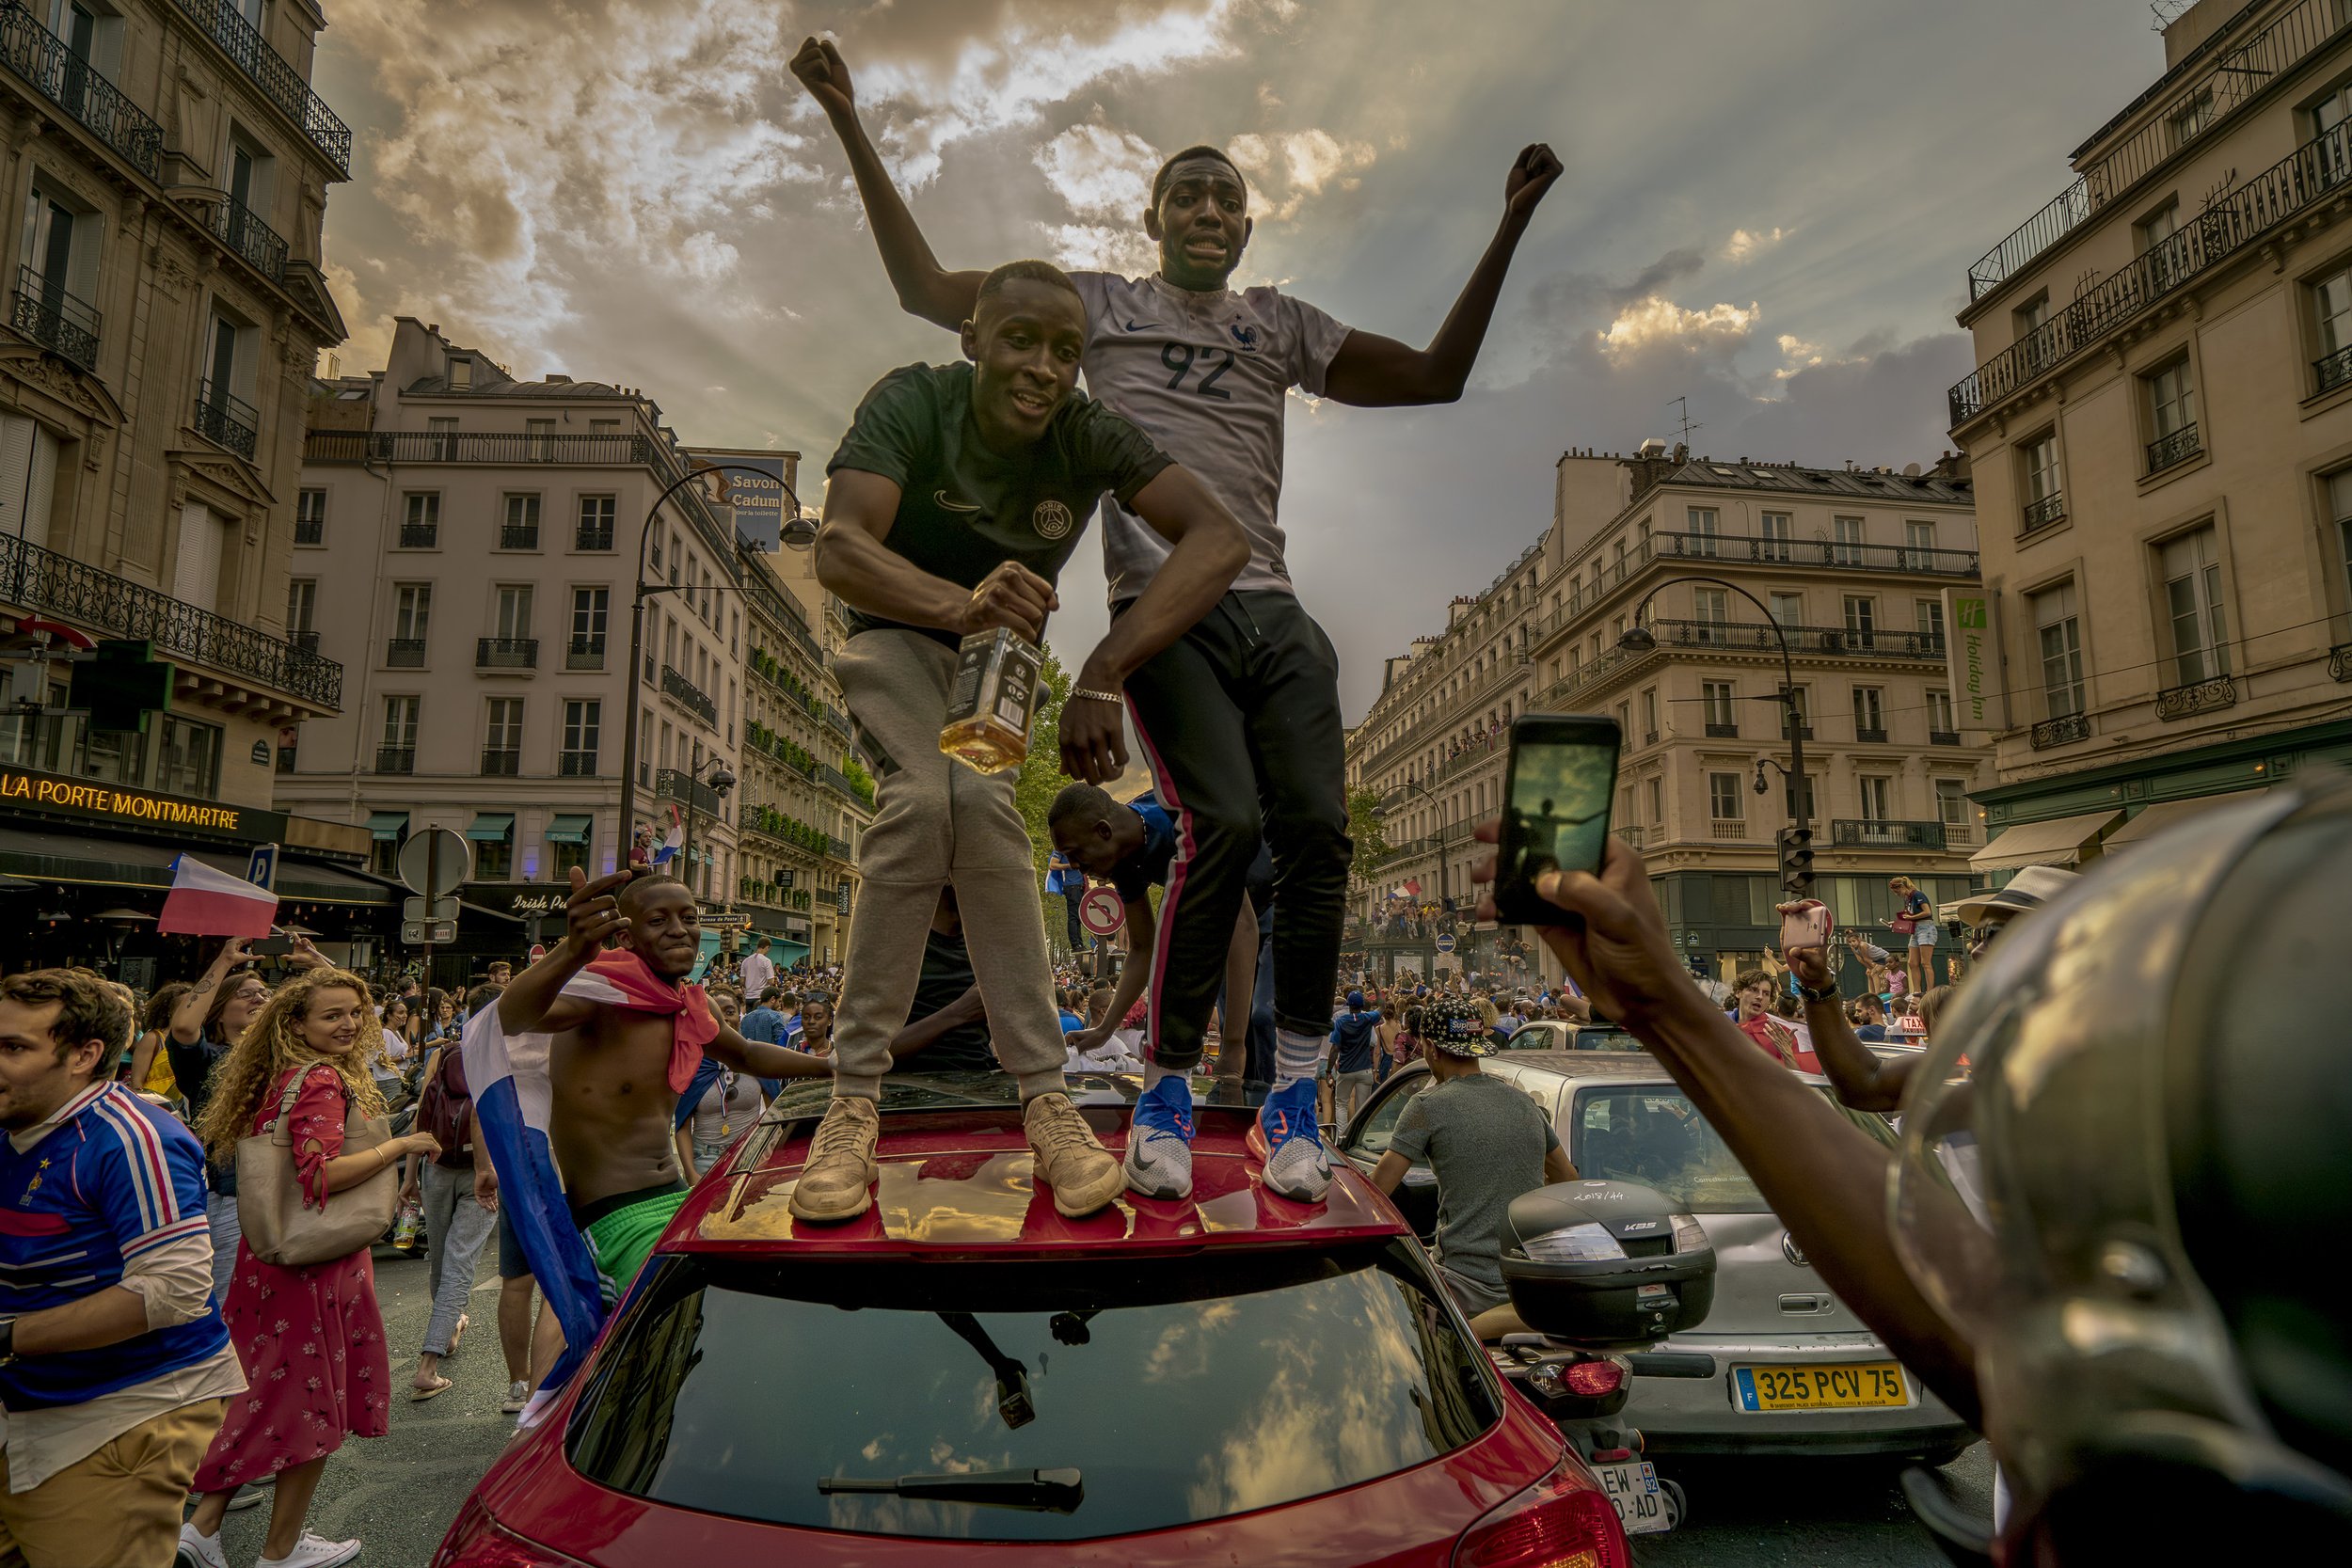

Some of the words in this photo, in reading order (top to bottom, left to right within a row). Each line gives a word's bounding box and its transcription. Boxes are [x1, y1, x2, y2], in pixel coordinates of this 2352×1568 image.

[1161, 341, 1235, 400] 92
[732, 475, 780, 489] Savon
[732, 494, 780, 508] Cadum
[1038, 502, 1063, 514] PARIS
[1966, 633, 1984, 693] Holiday
[1972, 696, 1987, 721] Inn
[1, 773, 30, 799] LA
[39, 780, 109, 810] PORTE
[113, 793, 240, 830] MONTMARTRE
[253, 858, 267, 883] P
[511, 895, 548, 909] Irish
[549, 895, 567, 910] Pu
[1905, 1019, 1923, 1028] TAX
[1759, 1371, 1810, 1400] 325
[1814, 1370, 1860, 1398] PCV
[1866, 1370, 1899, 1397] 75
[1746, 1392, 1753, 1402] F
[1645, 1479, 1657, 1491] 92
